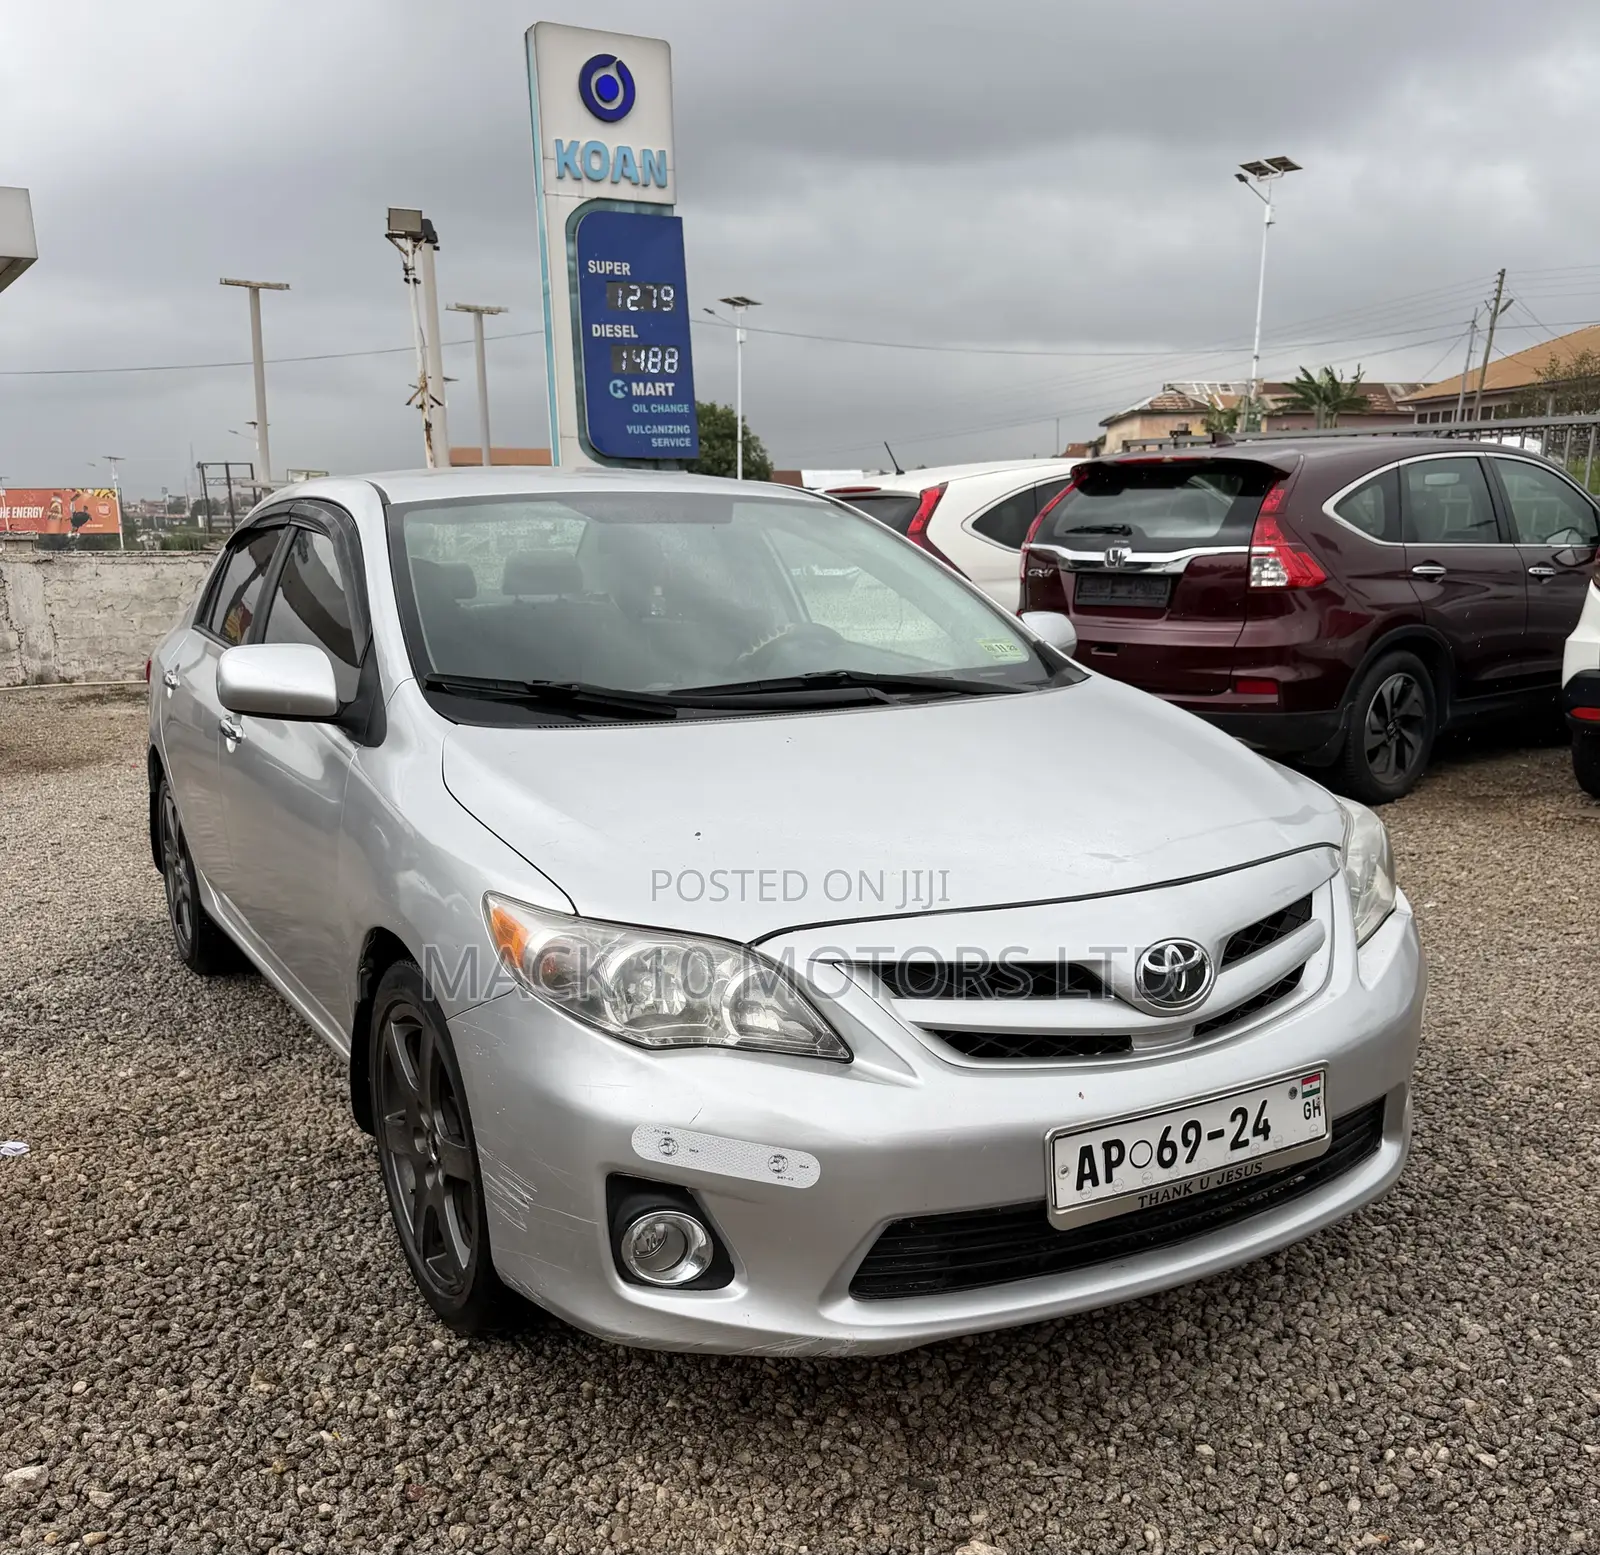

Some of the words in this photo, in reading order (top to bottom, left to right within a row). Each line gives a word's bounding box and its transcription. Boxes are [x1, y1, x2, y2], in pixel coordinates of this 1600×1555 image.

[554, 138, 668, 188] KOAN
[587, 259, 631, 276] SUPER
[591, 323, 639, 338] DIESEL
[631, 382, 675, 396] MART
[632, 403, 648, 413] OIL
[650, 403, 690, 413] CHANGE
[626, 424, 691, 434] VULCANIZING
[651, 438, 692, 448] SERVICE
[12, 506, 44, 519] ENERGY
[1303, 1099, 1322, 1121] GH
[1156, 1099, 1272, 1169] 69-24
[1138, 1181, 1193, 1208] THANK
[1199, 1176, 1211, 1190] U
[1216, 1161, 1263, 1185] JESUS
